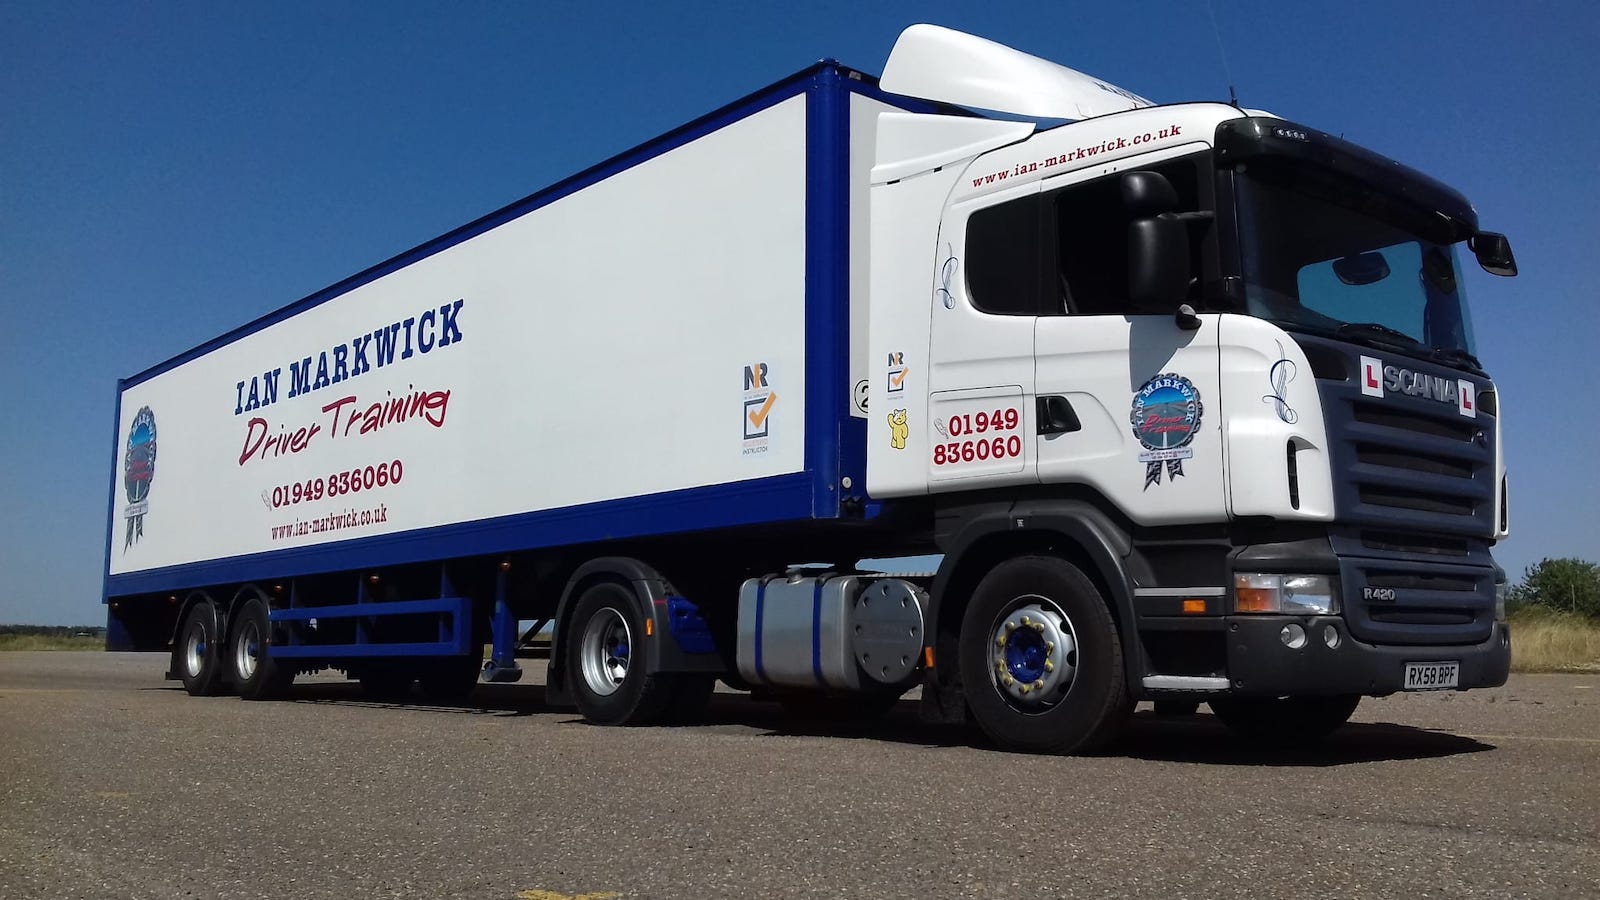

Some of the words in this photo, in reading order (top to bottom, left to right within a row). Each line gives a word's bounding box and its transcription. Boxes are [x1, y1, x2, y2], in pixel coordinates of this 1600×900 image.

[973, 124, 1182, 188] www.ian-markwick.co.uk
[234, 368, 281, 415] IAN
[288, 299, 464, 399] MARKWICK
[1366, 365, 1378, 389] L
[1383, 365, 1459, 405] SCANIA
[1142, 379, 1196, 424] MARKWICK
[1463, 388, 1472, 410] L
[239, 417, 321, 466] Driver
[322, 384, 451, 427] Training
[949, 407, 1019, 437] 01949
[933, 435, 1021, 465] 836060
[272, 478, 324, 508] 01949
[327, 459, 403, 497] 836060
[271, 503, 387, 540] www.ian-markwick.co.uk
[1409, 667, 1437, 685] RX58
[1438, 666, 1456, 685] BPF
